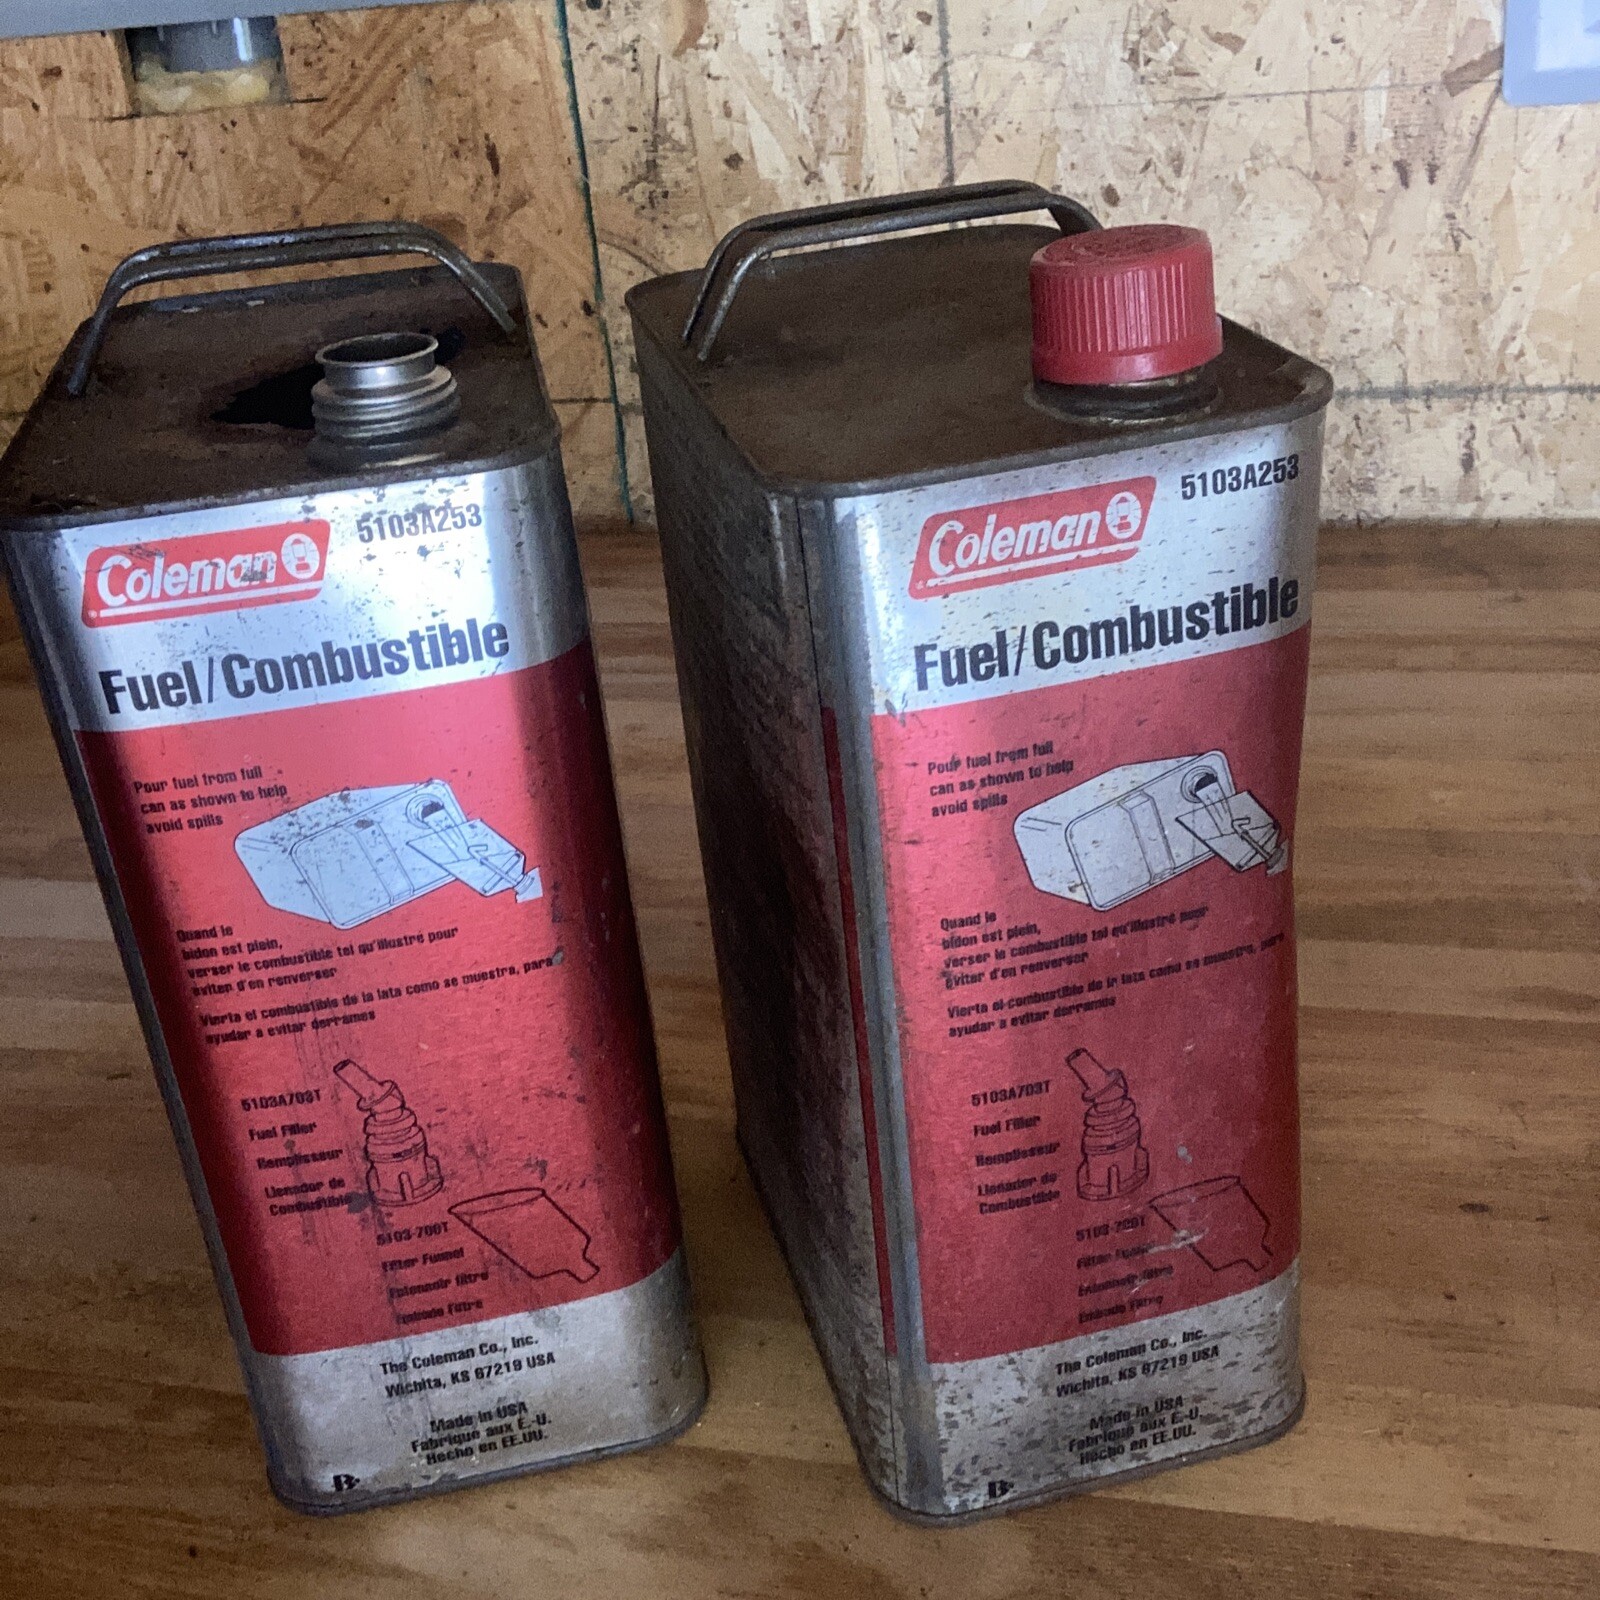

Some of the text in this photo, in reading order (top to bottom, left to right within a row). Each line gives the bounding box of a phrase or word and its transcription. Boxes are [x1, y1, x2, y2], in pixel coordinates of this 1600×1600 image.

[1180, 454, 1300, 500] 5103A253
[357, 503, 483, 543] 5103A253
[929, 508, 1101, 576] Coleman
[97, 550, 277, 608] Coleman
[914, 576, 1299, 691] Fuel/Combustible
[99, 618, 510, 715] Fuel/Combustible
[928, 756, 961, 775] Pour
[966, 753, 991, 769] fuel
[995, 748, 1028, 763] from
[134, 766, 262, 794] Pour fuel from full
[930, 783, 954, 796] can
[959, 779, 975, 792] as
[980, 770, 1024, 788] shown
[1029, 766, 1042, 779] to
[141, 785, 287, 814] can as shown to help
[932, 793, 1008, 817] avoid spills
[146, 814, 223, 834] avoid spills
[176, 925, 233, 942] Quand le
[941, 913, 981, 931] Quand
[982, 929, 1003, 943] est
[188, 964, 234, 978] verser
[238, 962, 250, 972] le
[254, 950, 333, 970] combustible
[337, 945, 355, 957] tel
[428, 927, 458, 944] pour
[222, 943, 243, 955] est
[268, 967, 337, 987] renverser
[200, 1012, 241, 1027] Vierta
[245, 1010, 257, 1021] el
[261, 999, 339, 1019] combustible
[377, 988, 402, 1000] lata
[406, 980, 439, 995] como
[444, 976, 458, 988] se
[948, 1002, 988, 1018] Vierta
[206, 1030, 251, 1045] ayudar
[256, 1028, 263, 1038] a
[267, 1022, 306, 1037] evitar
[949, 1021, 995, 1038] ayudar
[1011, 1009, 1049, 1027] evitar
[971, 1080, 1050, 1106] 5103A703T
[380, 1361, 408, 1375] The
[412, 1347, 475, 1370] Coleman
[512, 1335, 539, 1349] Inc.
[1055, 1361, 1081, 1376] The
[1085, 1343, 1147, 1368] Coleman
[1183, 1329, 1208, 1342] Inc.
[386, 1352, 556, 1398] Wichita, KS 67219 USA
[1057, 1345, 1219, 1398] Wichita, KS 67219 USA
[430, 1402, 528, 1433] Made in USA
[1154, 1395, 1184, 1413] USA
[426, 1446, 473, 1465] Hecho
[478, 1438, 498, 1454] en
